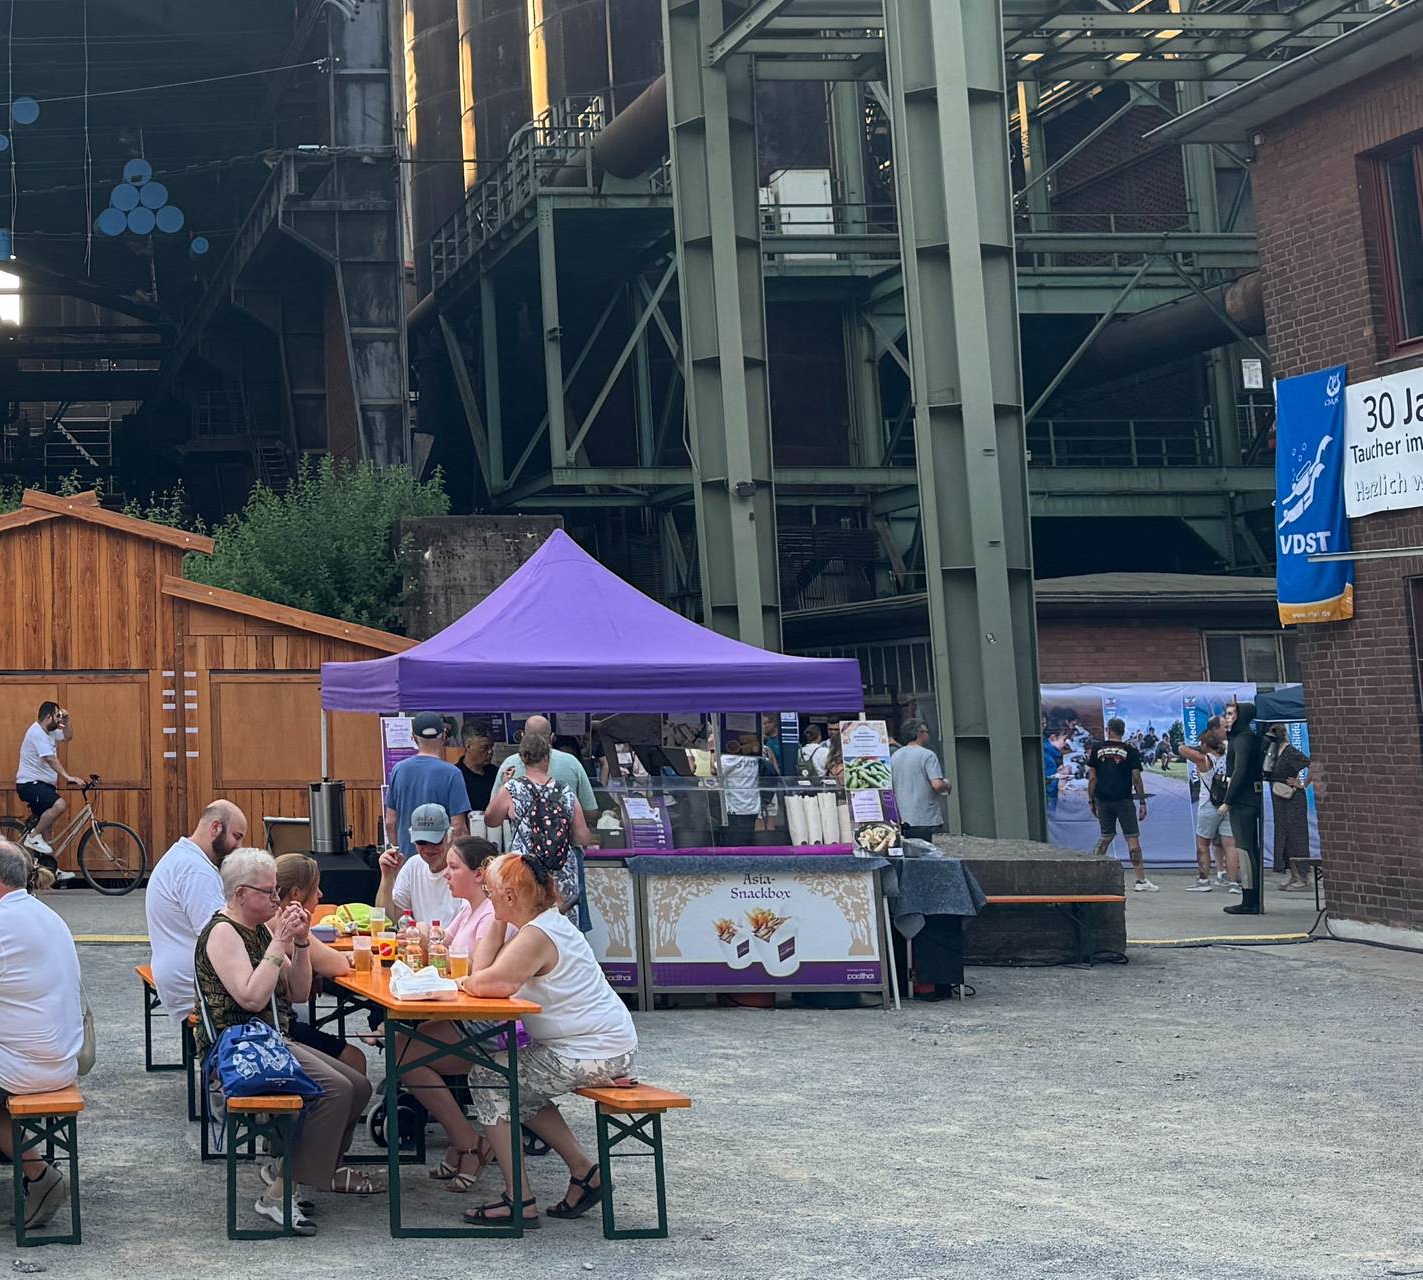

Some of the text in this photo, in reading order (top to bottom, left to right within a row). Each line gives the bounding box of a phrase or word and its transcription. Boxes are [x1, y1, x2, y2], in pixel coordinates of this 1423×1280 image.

[1363, 392, 1395, 433] 30
[1350, 438, 1402, 464] Taucher
[1355, 472, 1408, 502] Herzlich
[1280, 531, 1332, 555] VDST
[1291, 722, 1302, 752] sbildu
[743, 873, 776, 885] Asia-
[730, 887, 791, 900] Snackbox
